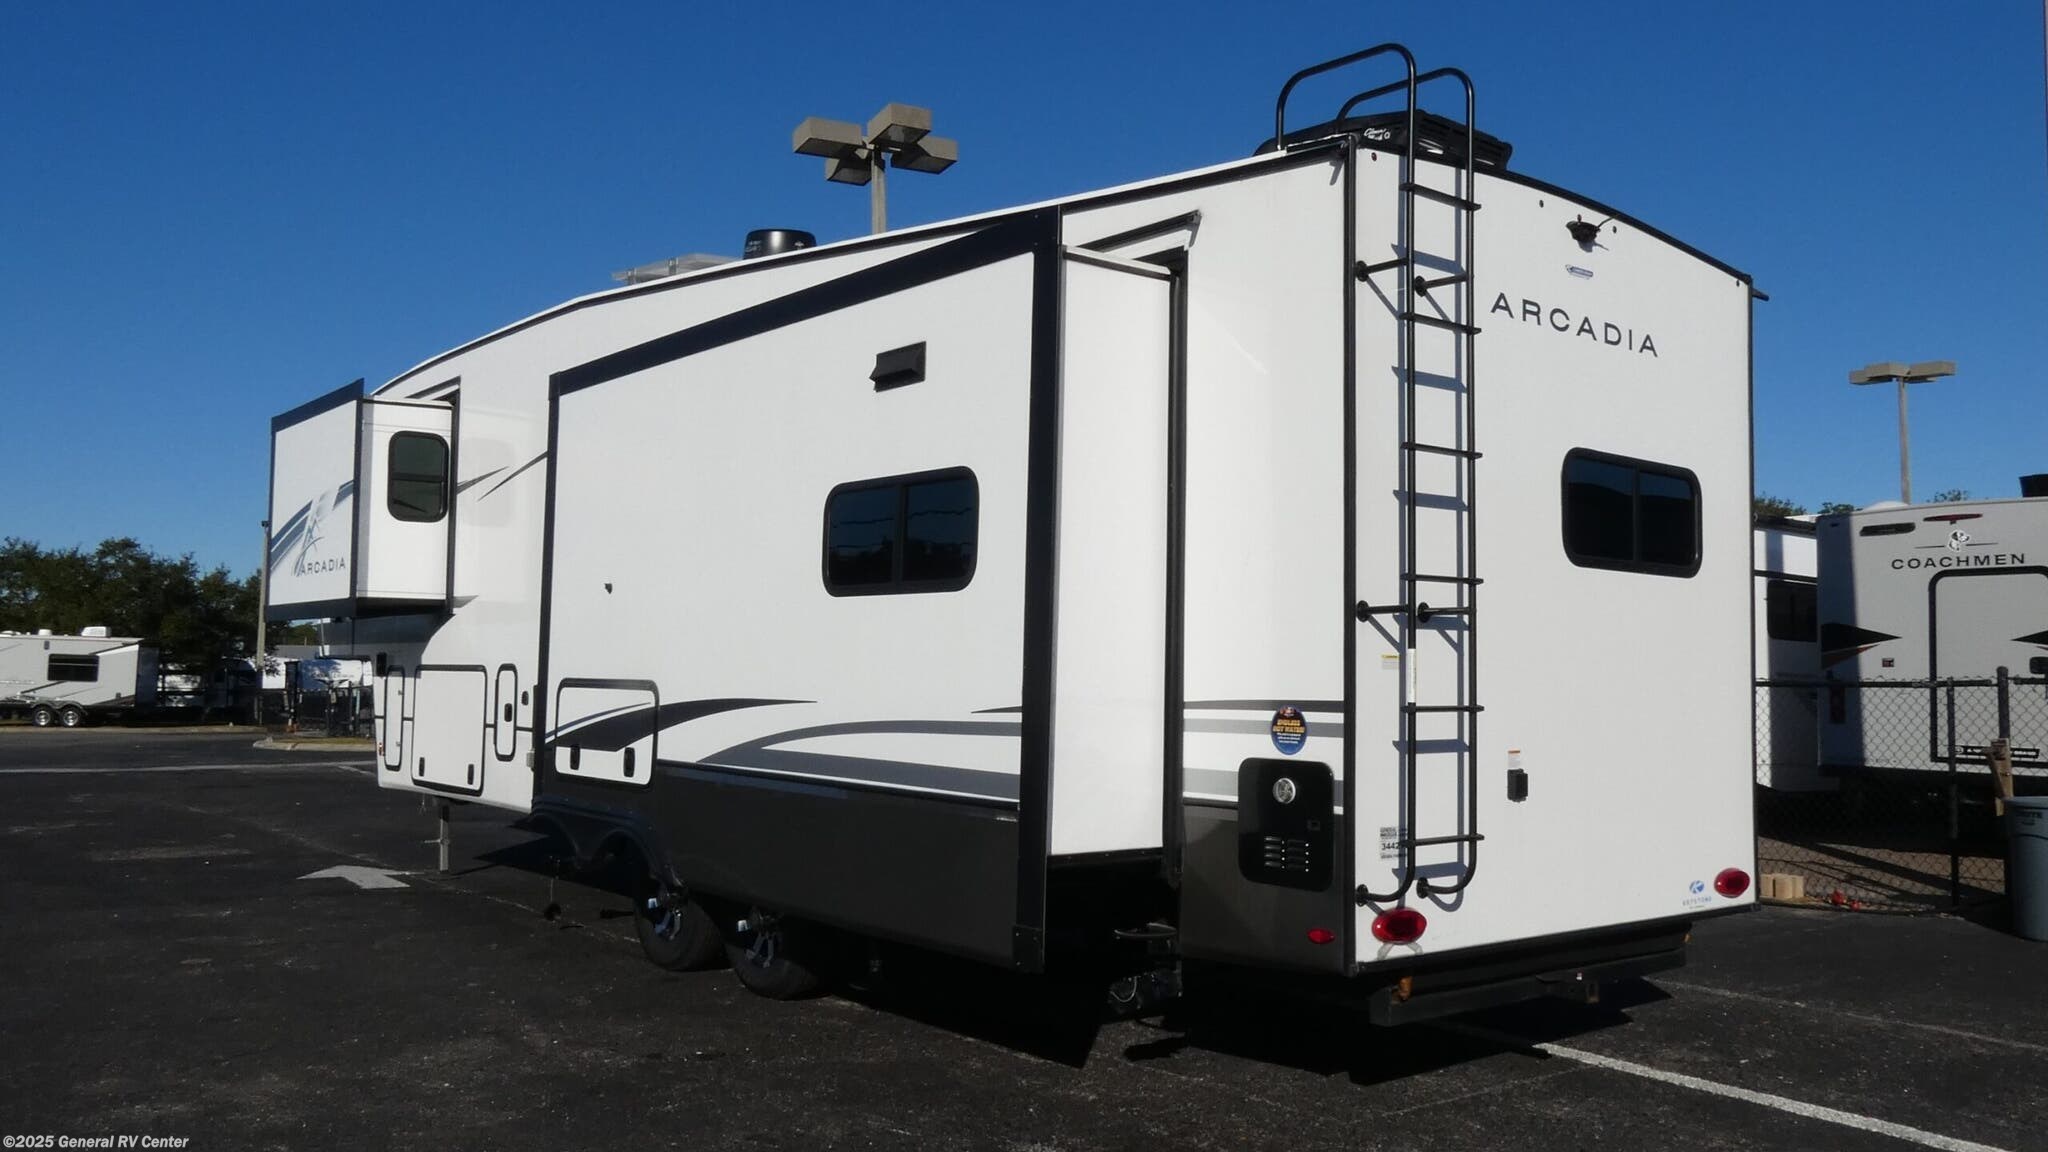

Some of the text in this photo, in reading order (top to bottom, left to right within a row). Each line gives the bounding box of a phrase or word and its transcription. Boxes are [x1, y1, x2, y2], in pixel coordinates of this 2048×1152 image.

[1490, 292, 1658, 357] ARCADIA
[300, 557, 346, 575] ARCADIA
[1891, 553, 2025, 570] COACHMEN
